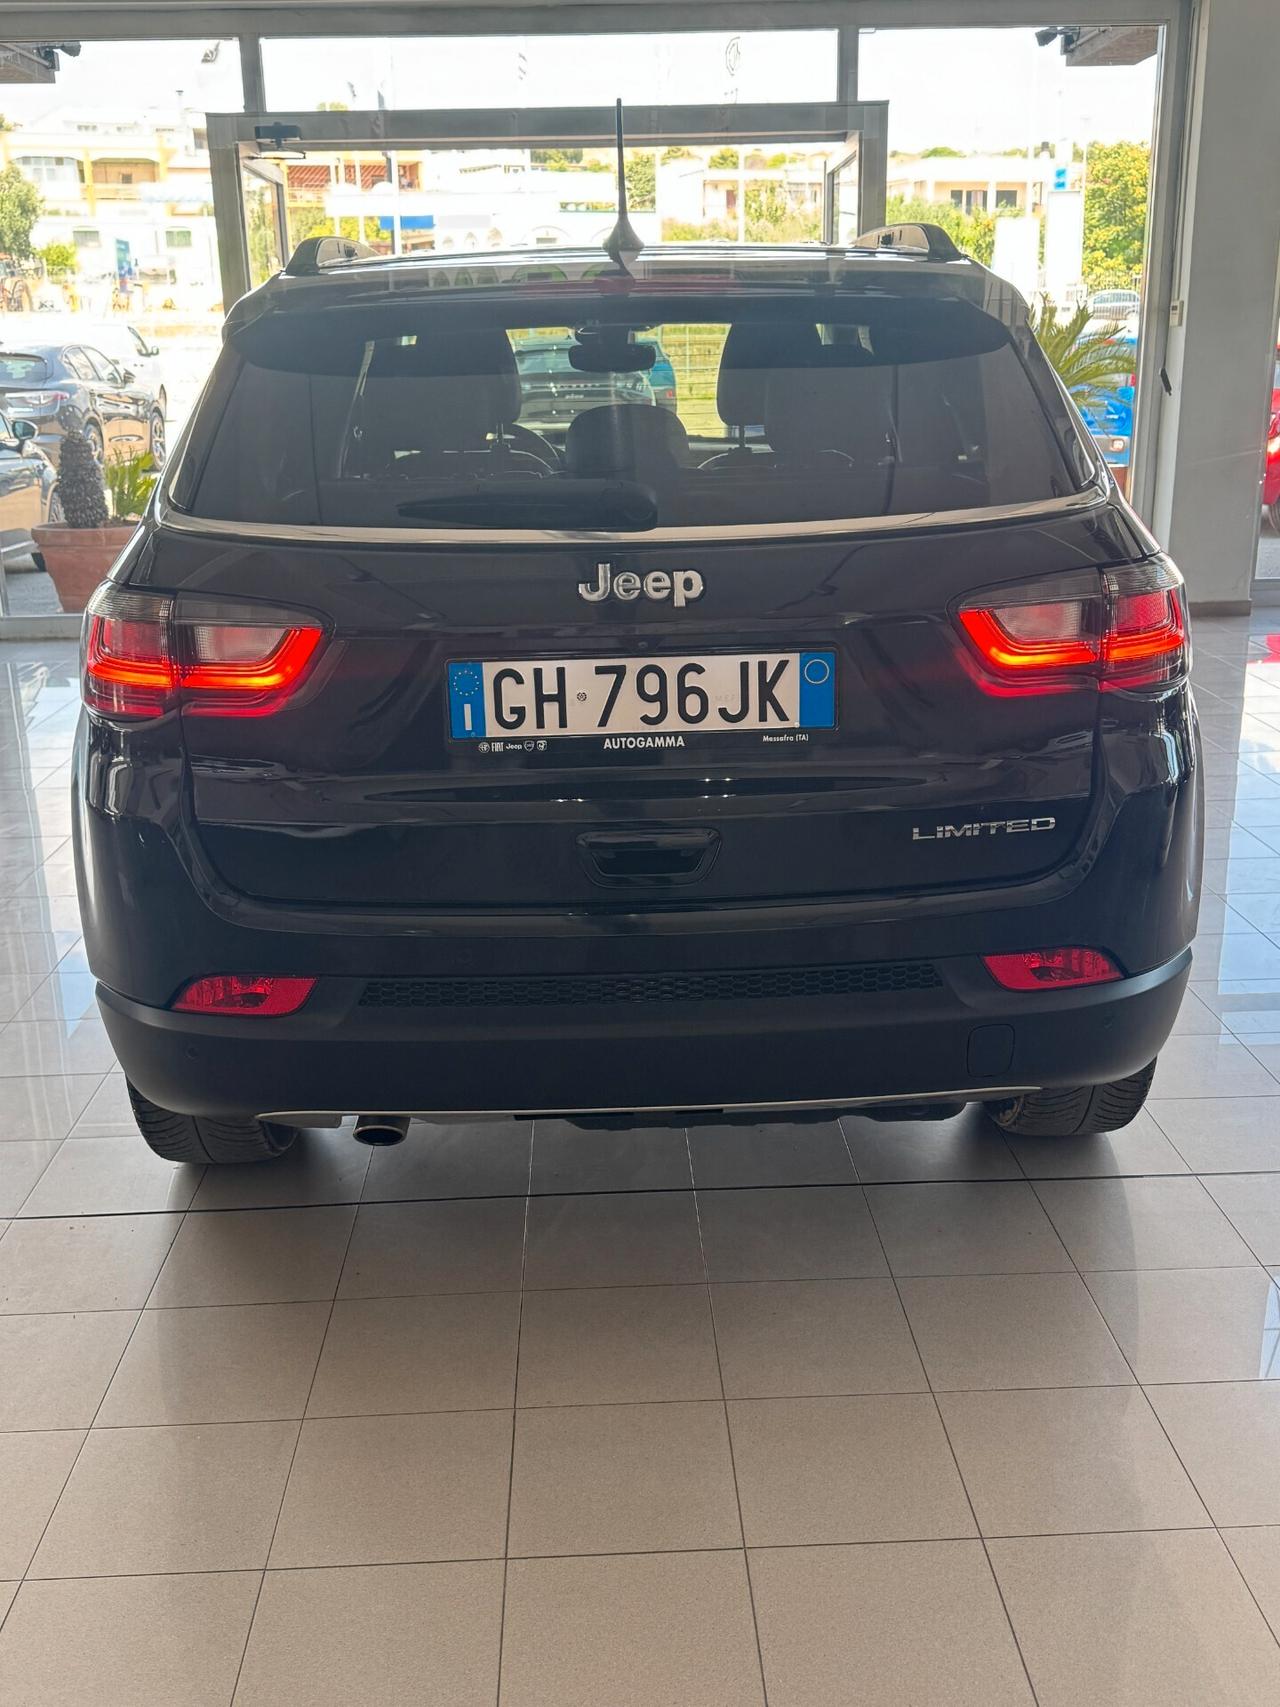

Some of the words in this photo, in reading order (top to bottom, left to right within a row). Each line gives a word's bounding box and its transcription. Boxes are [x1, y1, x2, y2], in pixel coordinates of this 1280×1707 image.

[578, 563, 704, 607] Jeep
[493, 667, 567, 730] GH
[603, 736, 685, 750] AUTOGAMMA
[912, 817, 1056, 840] LIMITED
